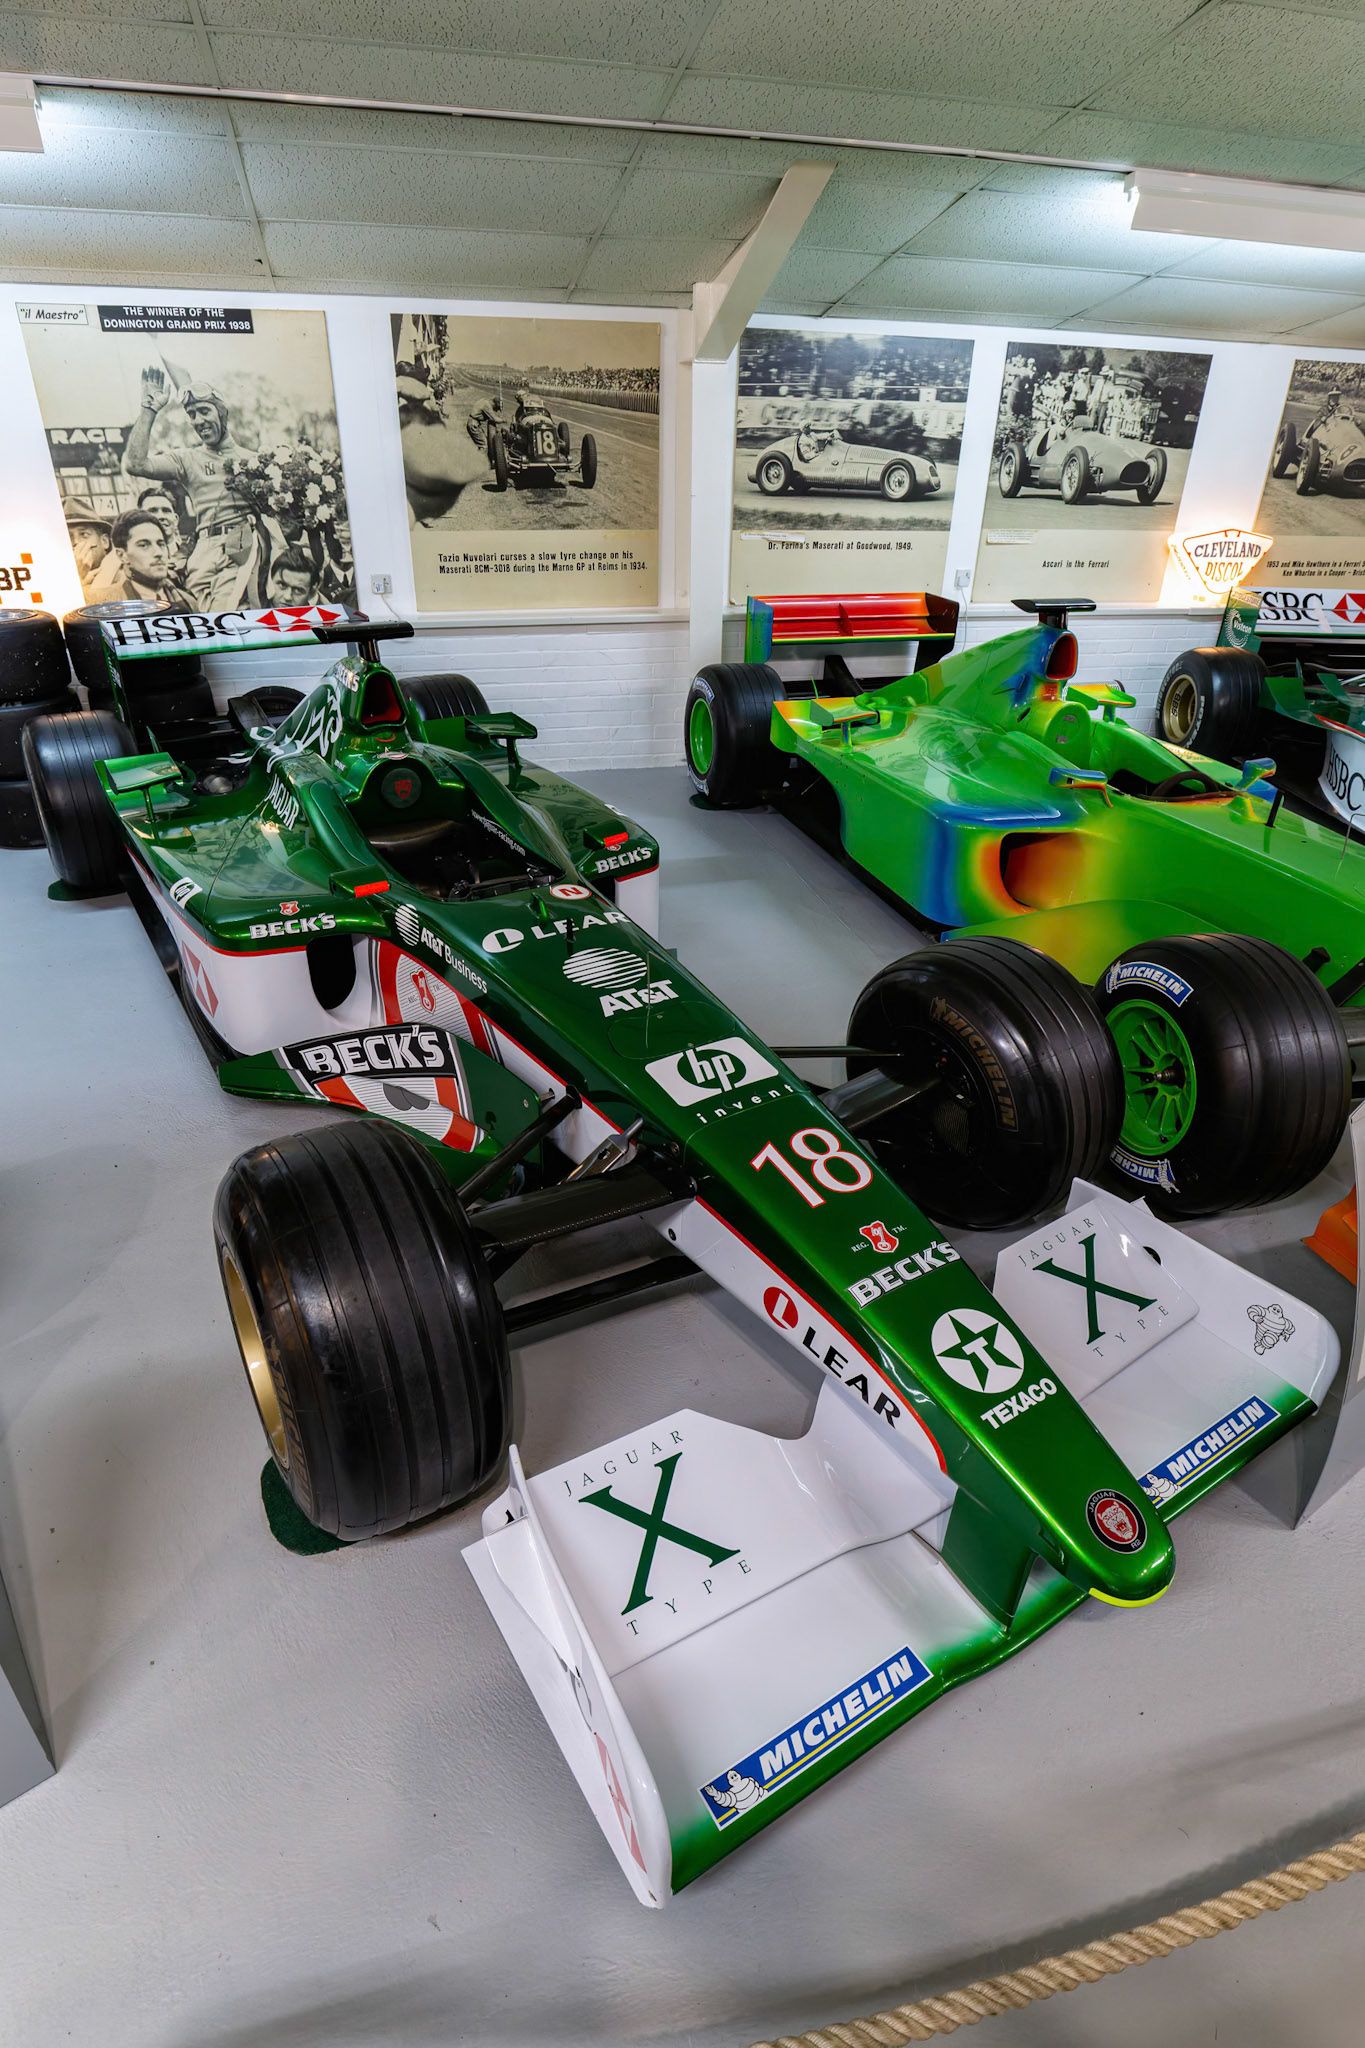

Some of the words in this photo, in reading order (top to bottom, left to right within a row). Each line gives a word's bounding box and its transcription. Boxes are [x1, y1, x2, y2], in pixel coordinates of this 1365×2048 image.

[104, 318, 164, 329] DONINGTON
[167, 319, 201, 330] GRAND
[204, 320, 226, 330] PRIX
[228, 320, 250, 331] 1938
[123, 306, 144, 316] THE
[146, 306, 186, 317] WINNER
[189, 307, 203, 317] OF
[205, 307, 225, 317] THE
[438, 553, 460, 562] Tazio
[463, 552, 497, 562] Nuvolari
[500, 553, 527, 561] curses
[530, 553, 535, 561] a
[538, 552, 556, 561] slow
[560, 551, 576, 561] tyre
[580, 551, 607, 561] change
[622, 550, 634, 559] his
[439, 564, 472, 574] Maserati
[513, 563, 535, 574] during
[538, 563, 549, 572] the
[552, 562, 574, 571] Marne
[577, 562, 585, 571] GP
[588, 562, 595, 571] at
[598, 562, 618, 571] Reims
[621, 562, 627, 570] in
[630, 561, 648, 571] 1934.
[768, 541, 779, 550] Dr.
[812, 541, 844, 550] Maserati
[846, 541, 854, 550] at
[856, 541, 893, 551] Goodwood,
[895, 542, 913, 551] 1949.
[1042, 560, 1063, 568] Ascari
[1066, 560, 1073, 568] in
[1074, 560, 1085, 568] the
[1088, 560, 1110, 568] Ferrari
[1194, 541, 1262, 558] CLEVELAND
[1343, 560, 1360, 568] Ferrari
[1328, 569, 1346, 577] Cooper
[106, 612, 251, 647] HSBC
[1326, 743, 1365, 811] HSBC
[265, 773, 300, 831] JAGUAR
[595, 846, 652, 874] BECK'S
[249, 911, 337, 940] BECK'S
[531, 911, 632, 940] LEAR
[420, 926, 444, 958] AT&T
[444, 946, 488, 995] Business
[1120, 965, 1184, 996] MICHELIN
[599, 979, 680, 1018] AT&T
[299, 1025, 445, 1075] BECK'S
[685, 1048, 737, 1093] hp
[943, 1011, 1017, 1129] MICHELIN
[696, 1083, 794, 1124] invent
[749, 1127, 874, 1209] 18
[1017, 1217, 1095, 1267] JAGUAR
[848, 1240, 961, 1308] BECK'S
[1032, 1232, 1159, 1345] X
[1093, 1305, 1169, 1358] TYPE
[802, 1326, 901, 1429] LEAR
[980, 1377, 1058, 1430] TEXACO
[563, 1429, 685, 1497] JAGUAR
[1166, 1401, 1266, 1480] MICHELIN
[1087, 1490, 1116, 1513] JAGUAR
[578, 1451, 741, 1616] X
[626, 1559, 752, 1636] TYPE
[758, 1654, 915, 1781] MICHELIN
